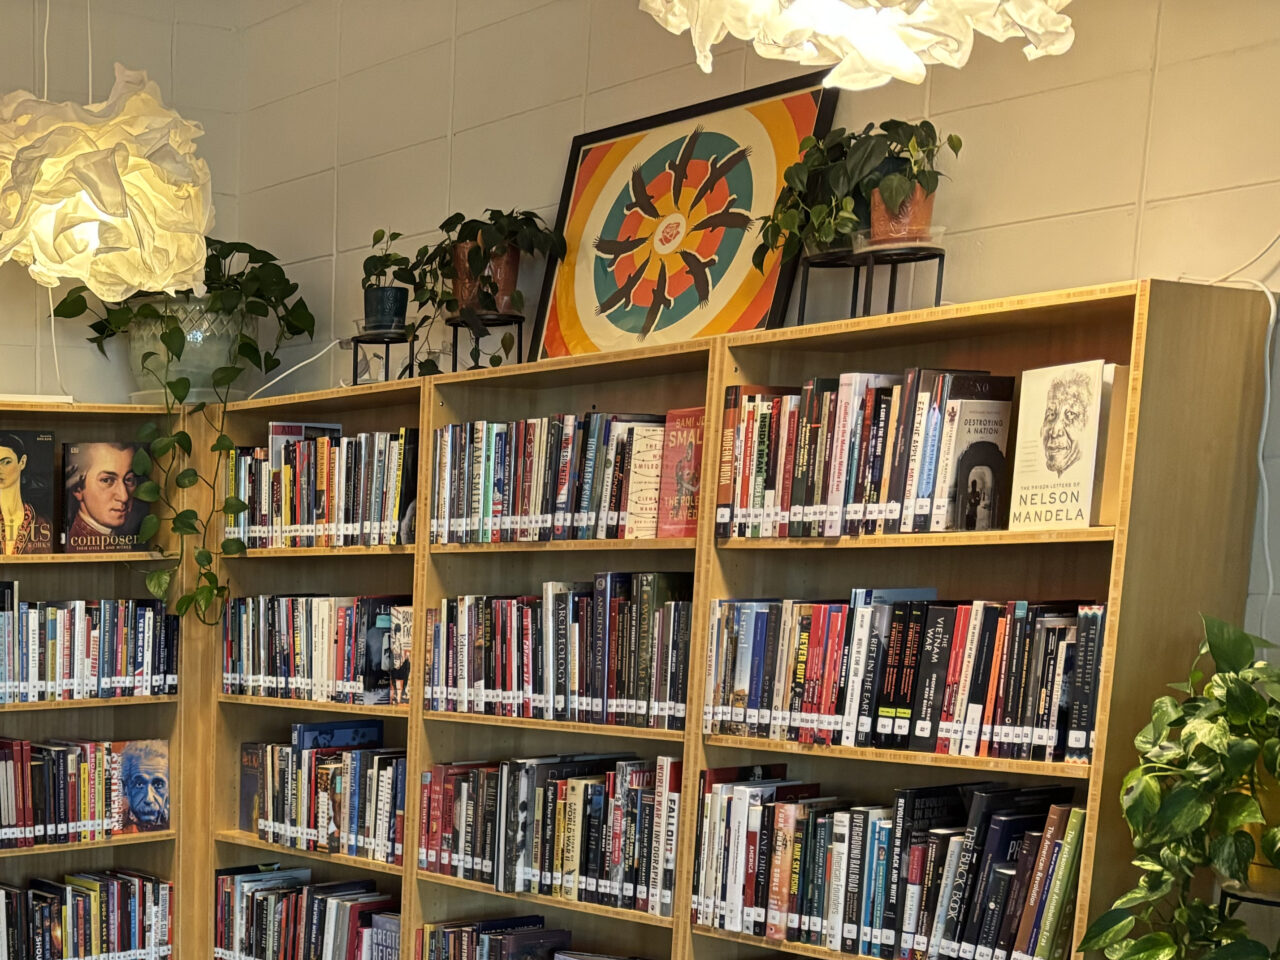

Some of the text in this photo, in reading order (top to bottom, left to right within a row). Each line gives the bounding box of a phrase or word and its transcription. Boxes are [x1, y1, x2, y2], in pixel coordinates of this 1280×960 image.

[916, 401, 925, 417] EAT
[676, 417, 695, 429] SAMI
[758, 413, 768, 446] INSIDE
[914, 420, 922, 437] THE
[964, 418, 1003, 427] DESTROYING
[669, 428, 703, 448] SMAL
[559, 433, 570, 486] UNPRESIDENTED
[720, 428, 735, 485] MODERN INDIA
[757, 449, 765, 474] IRAN
[910, 440, 920, 463] APPLE
[472, 428, 482, 514] ADAM SMITH
[1019, 490, 1080, 506] NELSON
[1012, 508, 1084, 524] MANDELA
[70, 533, 138, 551] composer
[596, 596, 604, 638] ANCIENT
[738, 609, 752, 648] Israel
[638, 603, 649, 680] WORLD WAR
[868, 638, 878, 658] RIFT
[924, 627, 935, 651] WAR
[930, 616, 945, 663] VIETNAM
[941, 634, 949, 648] THE
[458, 634, 466, 680] Educated
[796, 632, 809, 684] NEVER QUIT
[864, 673, 874, 690] THE
[860, 692, 871, 716] EART
[486, 788, 496, 811] ALLIES
[655, 764, 665, 824] WORLD WAR
[466, 800, 474, 825] FLOWERS
[894, 798, 905, 838] REVOLUTION
[565, 802, 574, 854] WORLD WAR
[665, 799, 677, 855] FALLOUT
[1066, 830, 1075, 843] The
[758, 830, 768, 885] ONE DROP
[847, 813, 864, 893] OVERGROUND RAILROAD
[892, 847, 901, 868] BLACK
[1057, 844, 1072, 880] Jacksonian
[791, 842, 802, 895] DARK SKY RISING
[891, 869, 899, 883] AND
[947, 826, 977, 922] THE BLACK BOOK
[1029, 826, 1055, 907] The American Revolution
[831, 850, 845, 915] American Founders
[889, 884, 897, 904] WHITE
[1044, 894, 1059, 931] Antebellum
[372, 927, 400, 949] GREATE
[1040, 931, 1051, 947] Eras
